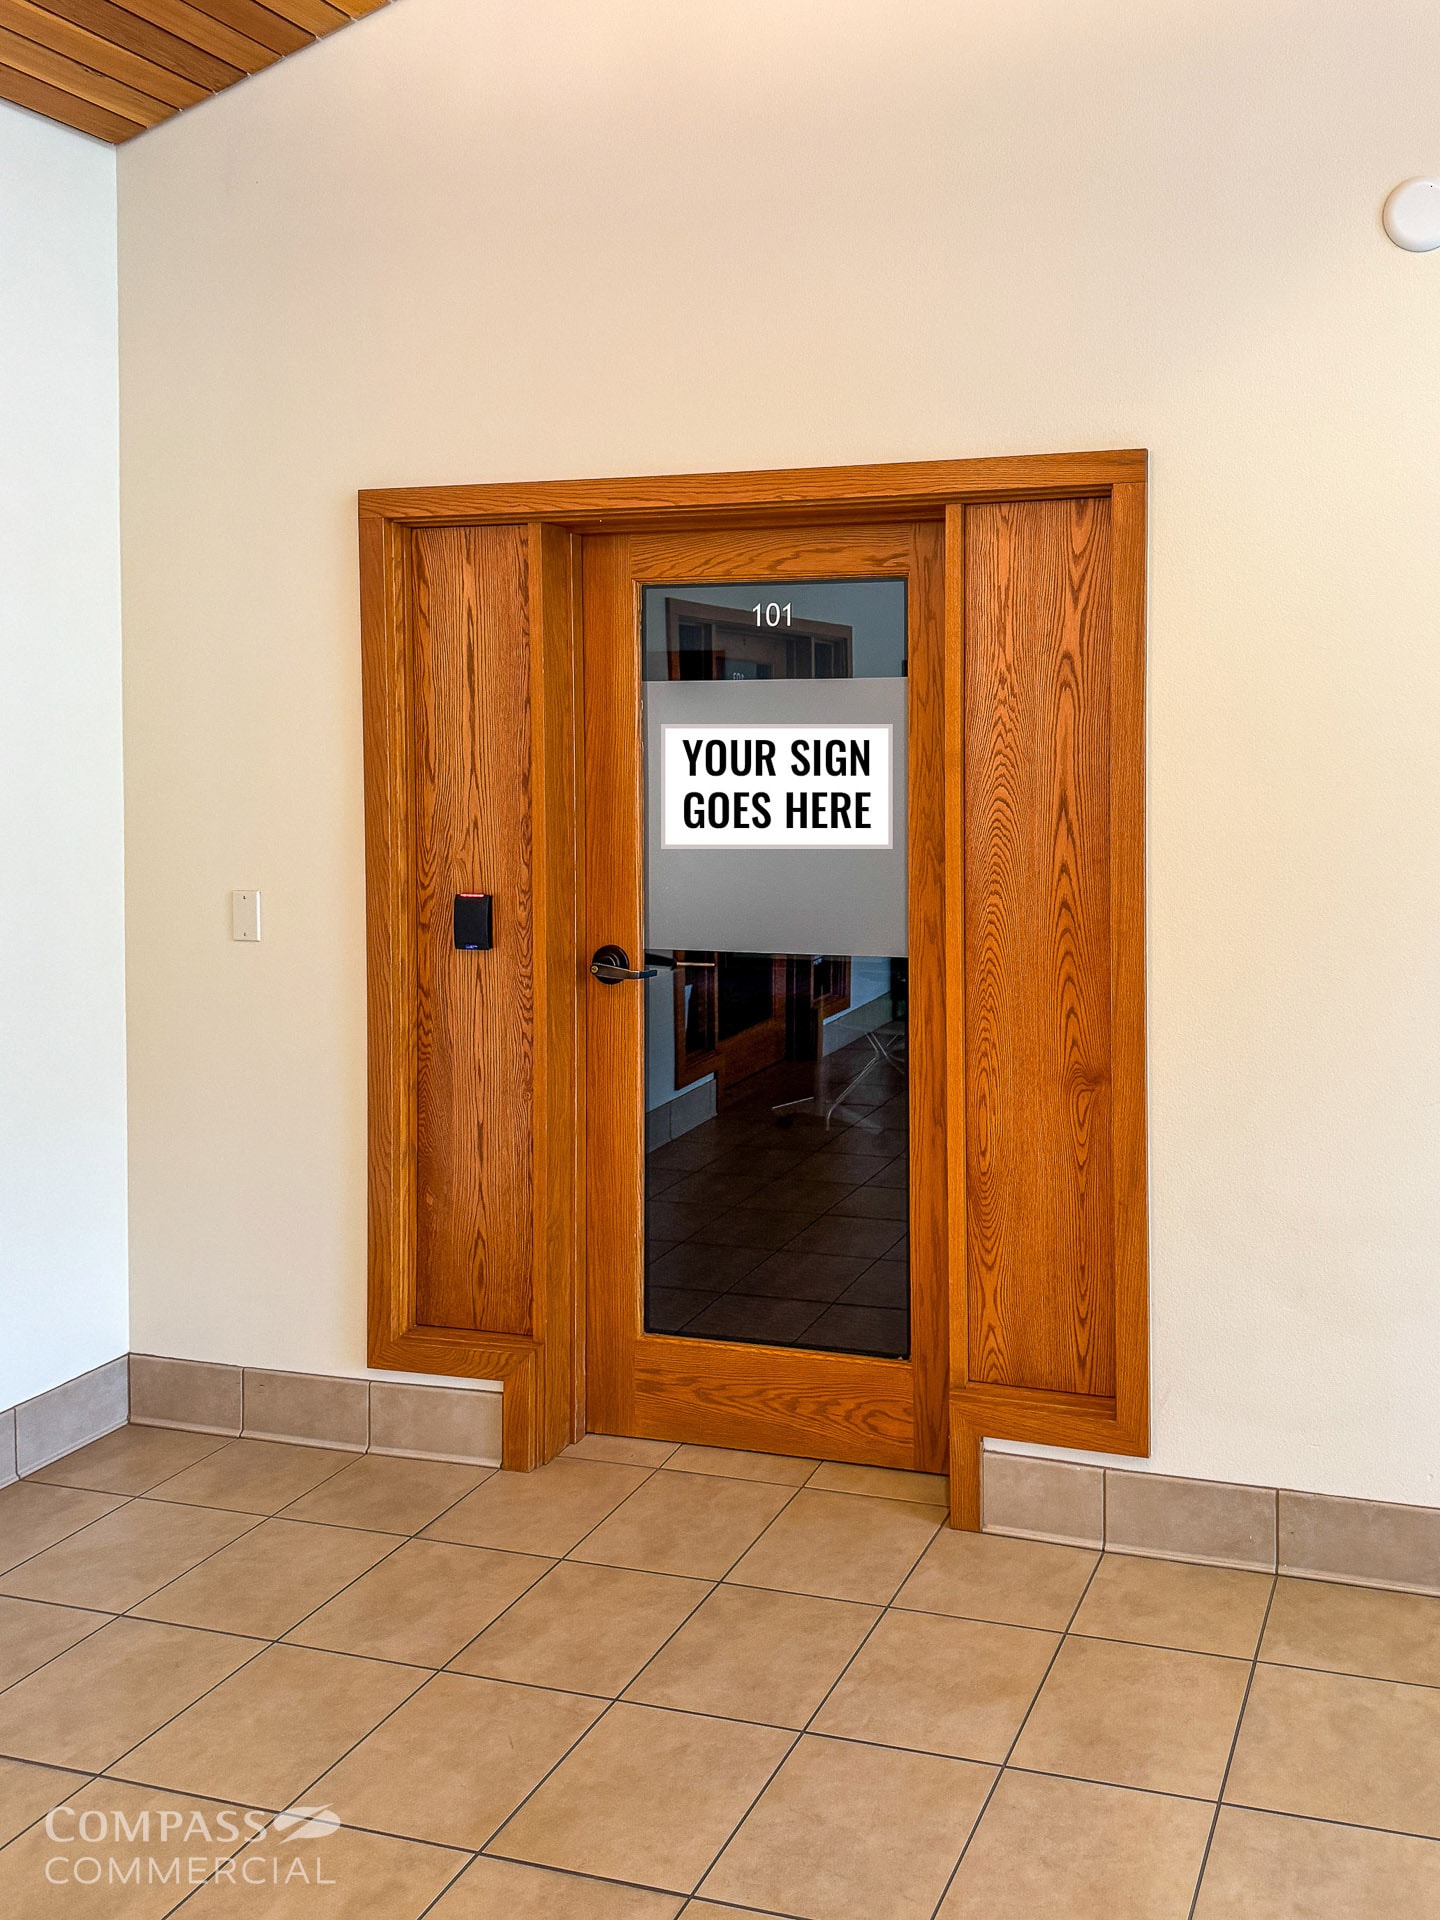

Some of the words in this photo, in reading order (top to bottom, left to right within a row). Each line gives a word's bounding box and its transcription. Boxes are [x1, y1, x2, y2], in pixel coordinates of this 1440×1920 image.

[752, 602, 791, 627] 101
[682, 739, 777, 777] YOUR
[790, 739, 870, 777] SIGN
[683, 791, 772, 829] GOES
[786, 791, 872, 829] HERE
